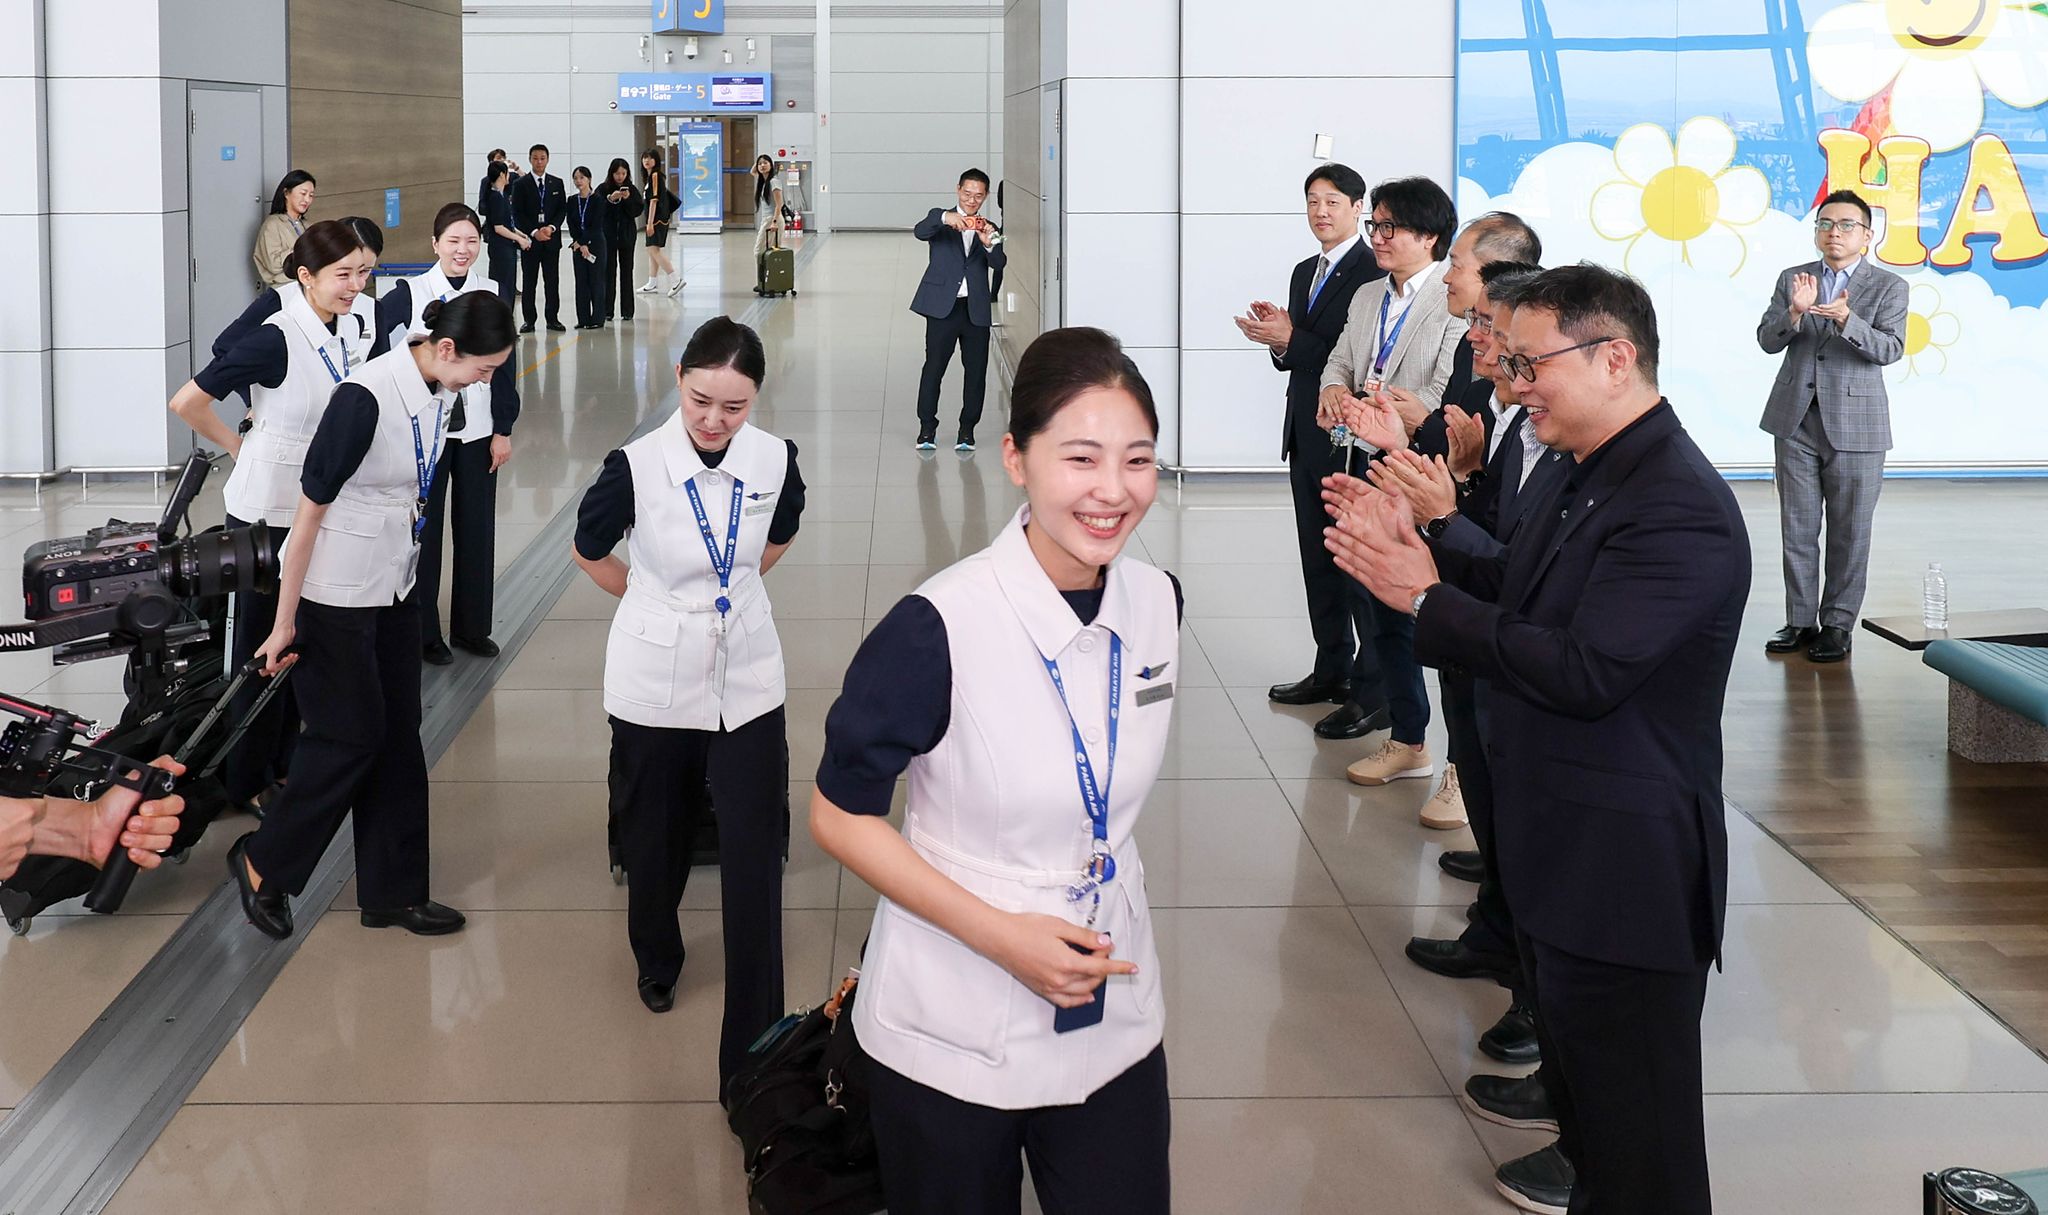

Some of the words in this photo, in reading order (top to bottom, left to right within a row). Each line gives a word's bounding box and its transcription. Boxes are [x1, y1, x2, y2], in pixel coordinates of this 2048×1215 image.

[652, 92, 672, 101] Gate
[696, 85, 706, 100] 5
[694, 157, 709, 181] 5
[1817, 128, 2048, 267] HA
[44, 550, 82, 560] SONY
[1080, 765, 1095, 802] PARATA
[1089, 802, 1100, 817] AIR
